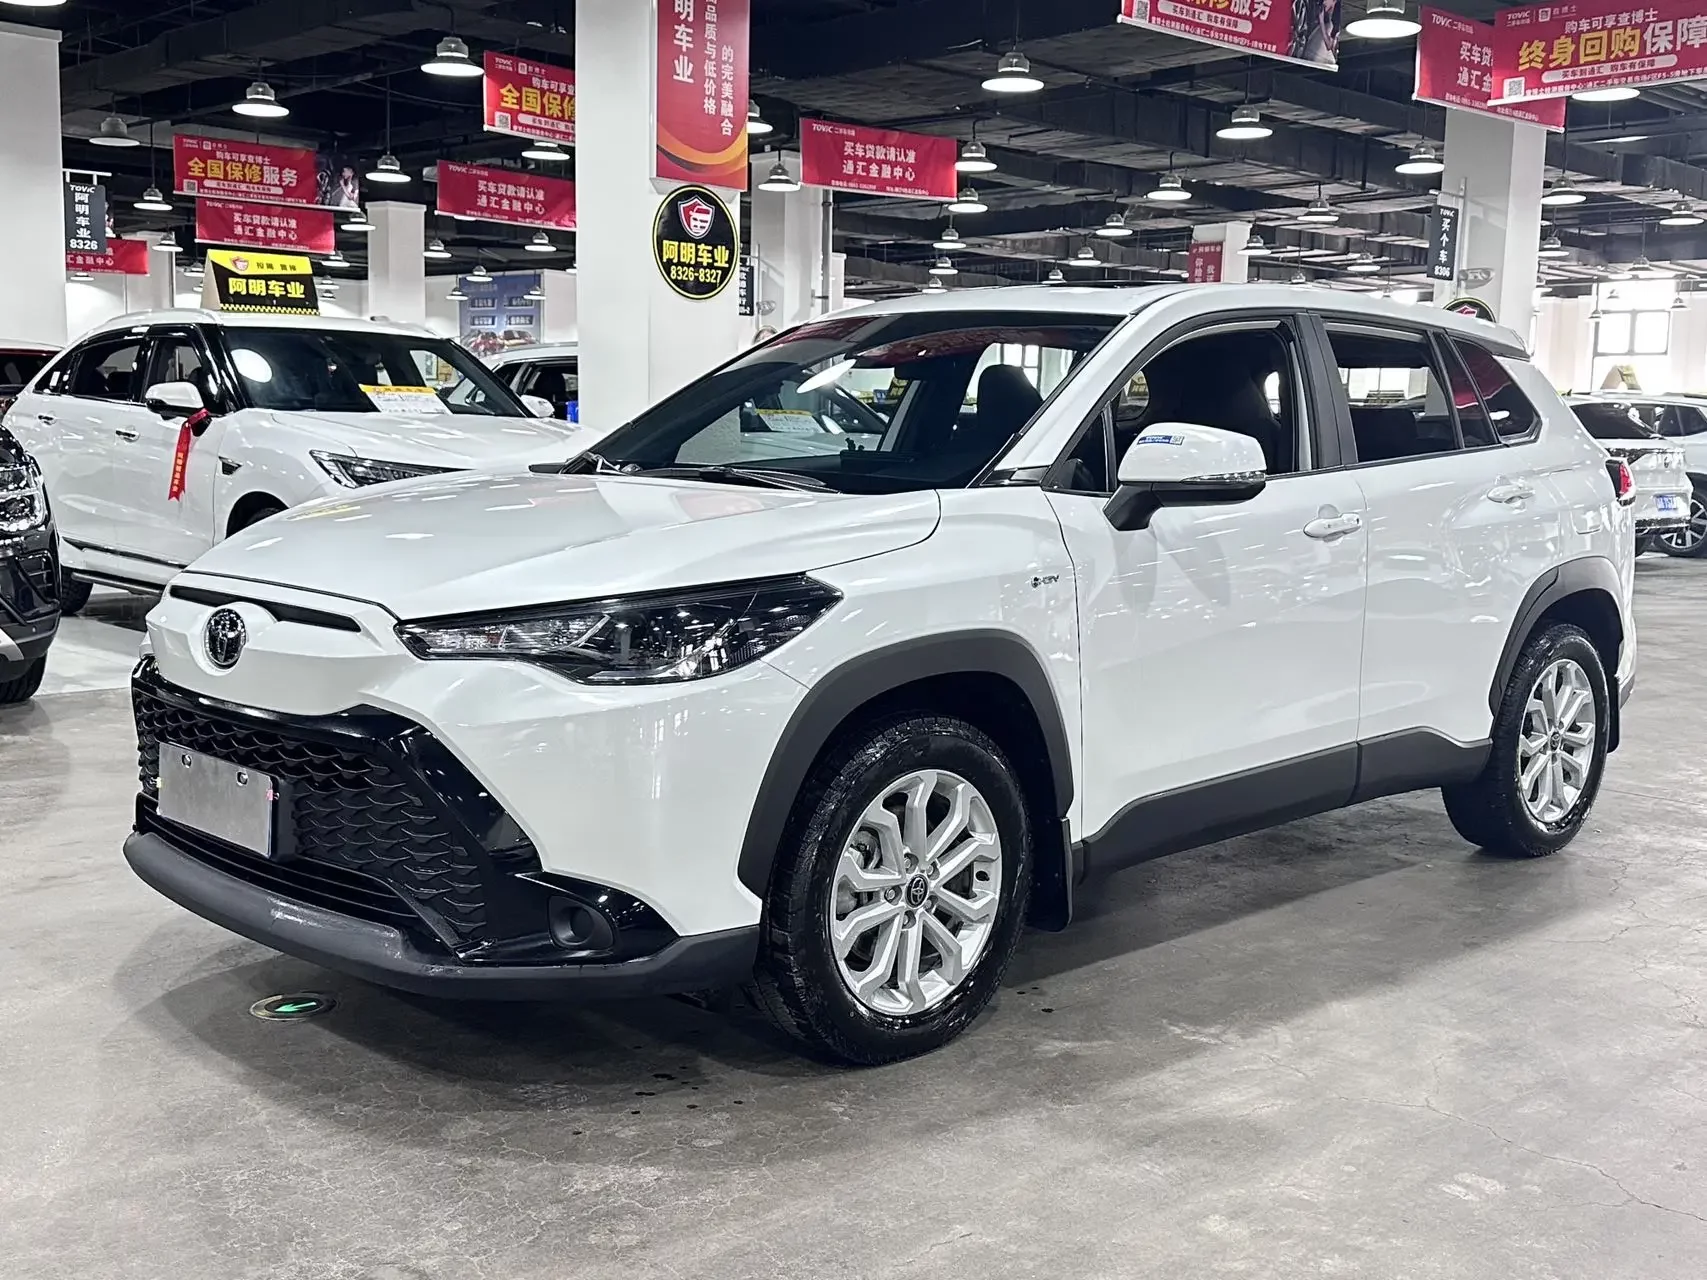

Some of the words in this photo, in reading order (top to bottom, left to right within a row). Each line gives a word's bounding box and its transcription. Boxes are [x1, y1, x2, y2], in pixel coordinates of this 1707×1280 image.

[1431, 13, 1452, 28] TOVIC
[1564, 8, 1658, 34] 购车可享查博士
[673, 0, 694, 83] 明车业
[1518, 14, 1707, 71] 终身回购保障
[703, 0, 718, 115] 品质与低价格
[1460, 41, 1493, 67] 买车贷
[1561, 66, 1605, 79] 买车到通汇
[1610, 59, 1656, 73] 购车有保障
[720, 45, 734, 136] 的完美融合
[812, 123, 834, 133] TOVIC
[844, 141, 916, 163] 买车贷款请认准
[187, 157, 298, 187] 全国保修服务
[842, 160, 915, 182] 通汇金融中心
[70, 184, 95, 194] TOVIC
[478, 180, 544, 201] 买车贷款请认准
[74, 192, 91, 238] 阿明车业
[476, 194, 544, 215] 通汇金融中心
[233, 212, 297, 229] 买车贷款请认准
[233, 225, 297, 240] 通汇金融中心
[1439, 218, 1451, 263] 买个车
[70, 238, 98, 250] 8326
[662, 240, 729, 267] 阿明车业
[670, 266, 721, 285] 8326-8327
[228, 277, 305, 298] 阿明车业
